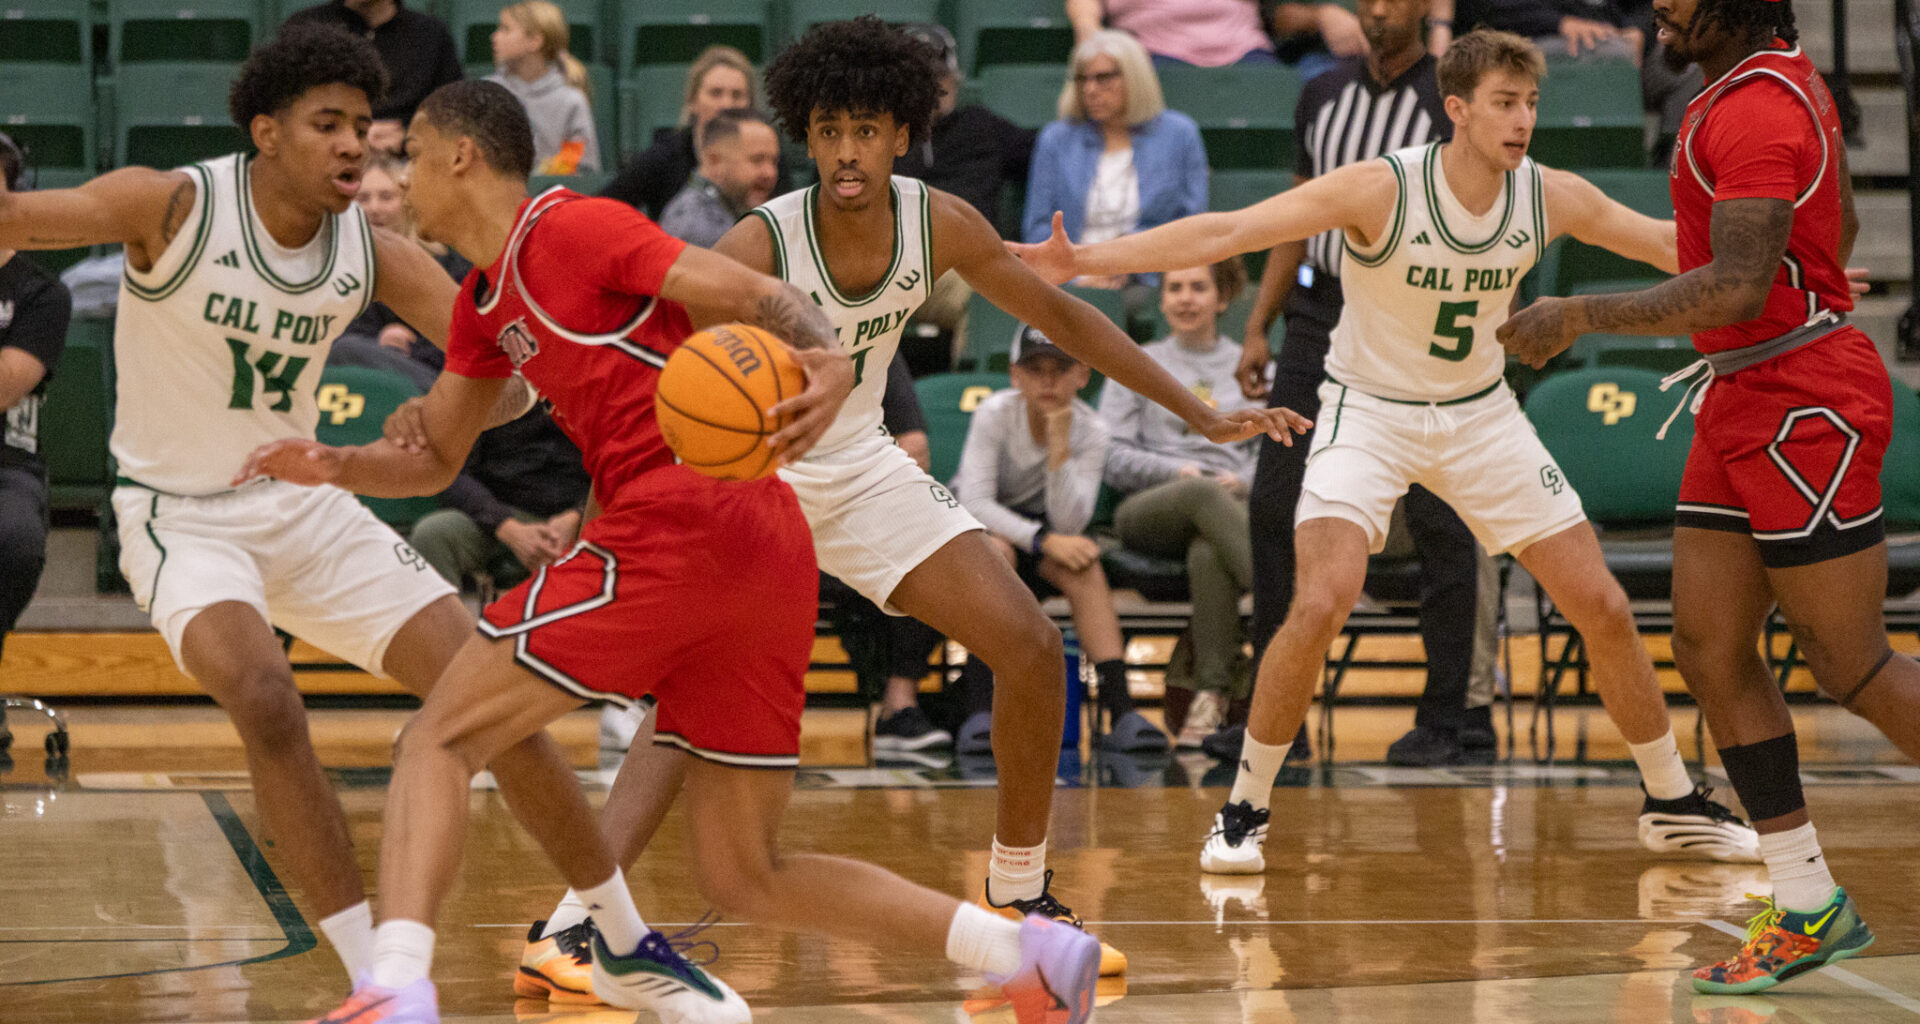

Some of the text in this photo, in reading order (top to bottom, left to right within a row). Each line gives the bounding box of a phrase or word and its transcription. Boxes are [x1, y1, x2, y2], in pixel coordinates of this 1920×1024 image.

[1406, 265, 1519, 292] CAL POLY
[203, 292, 337, 345] CAL POLY
[853, 308, 910, 347] POLY
[1428, 300, 1479, 362] 5
[225, 337, 311, 413] 14
[1587, 382, 1637, 426] CP
